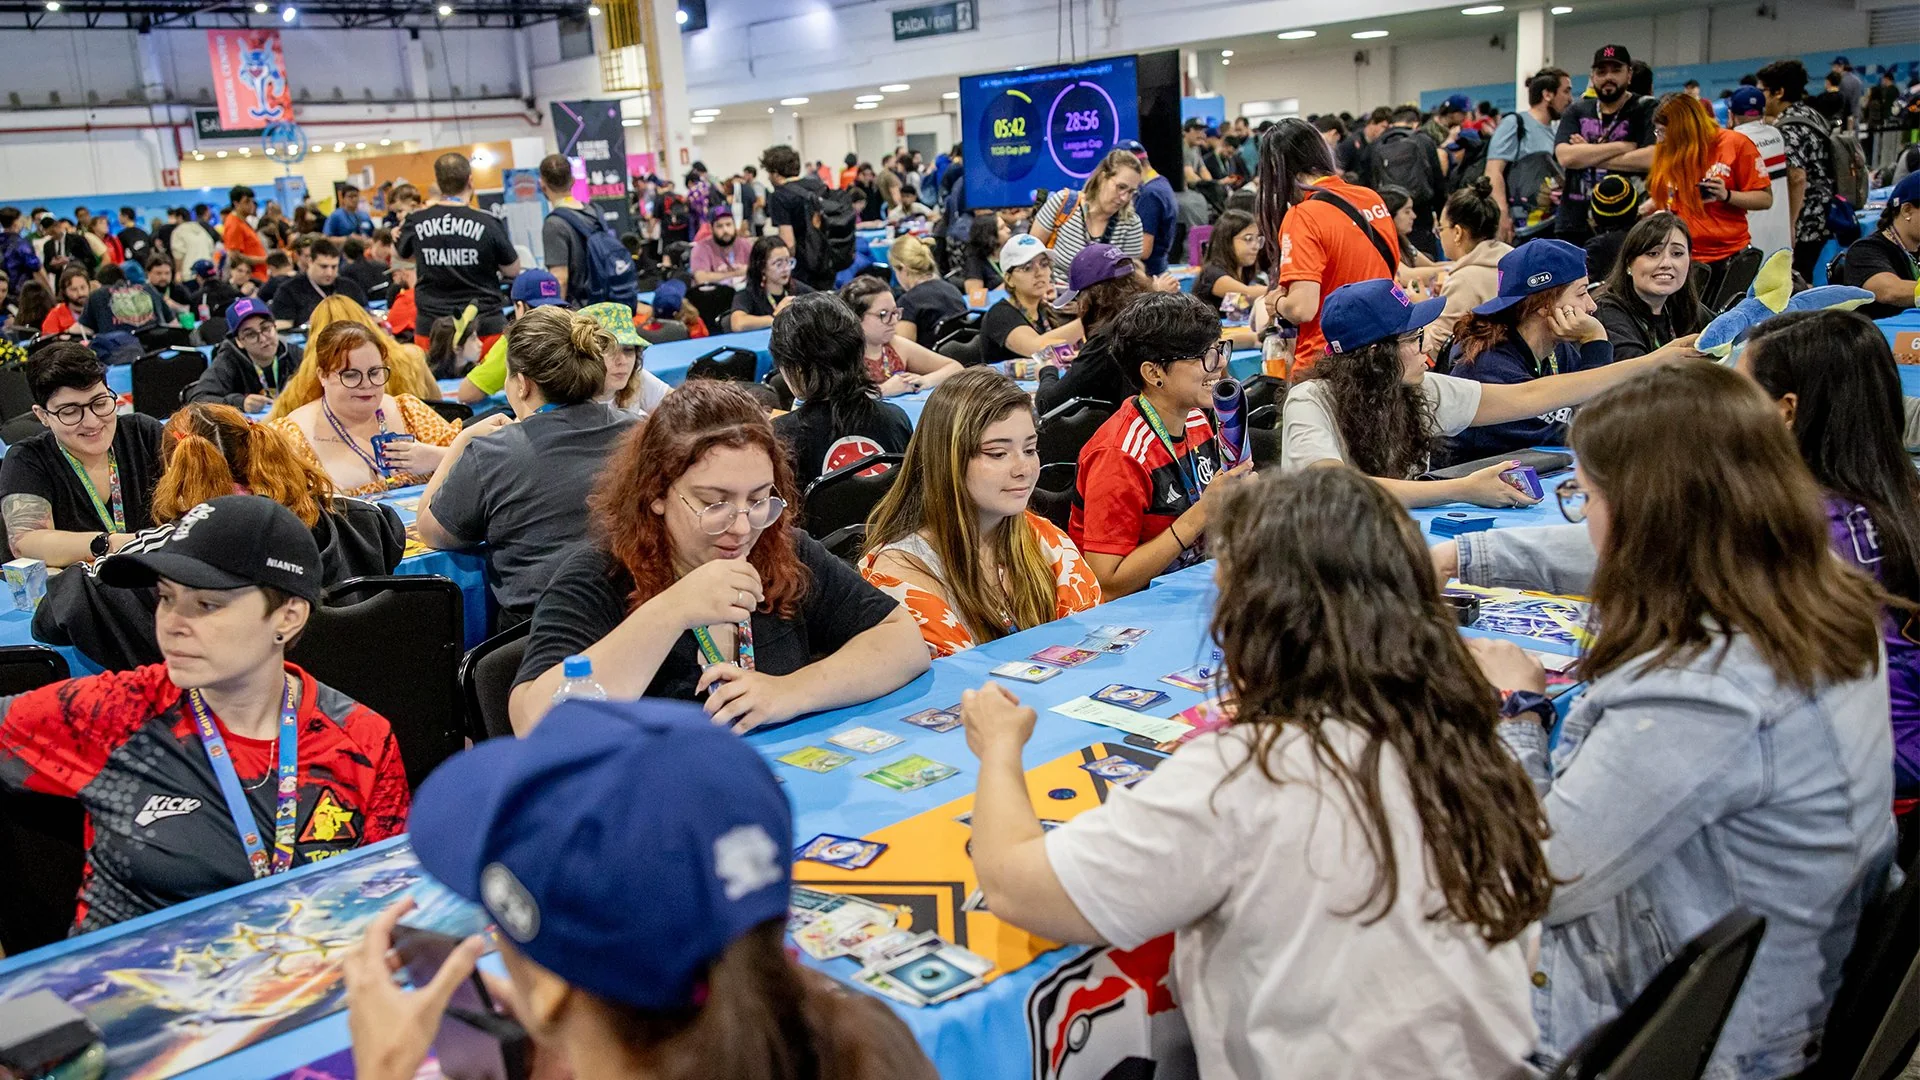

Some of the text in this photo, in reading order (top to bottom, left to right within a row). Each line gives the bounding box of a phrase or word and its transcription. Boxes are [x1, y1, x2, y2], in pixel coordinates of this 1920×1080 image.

[994, 116, 1026, 139] 05:42
[1065, 109, 1099, 132] 28:56
[414, 213, 485, 242] POKÉMON
[421, 247, 479, 266] TRAINER
[266, 557, 304, 575] NIANTIC
